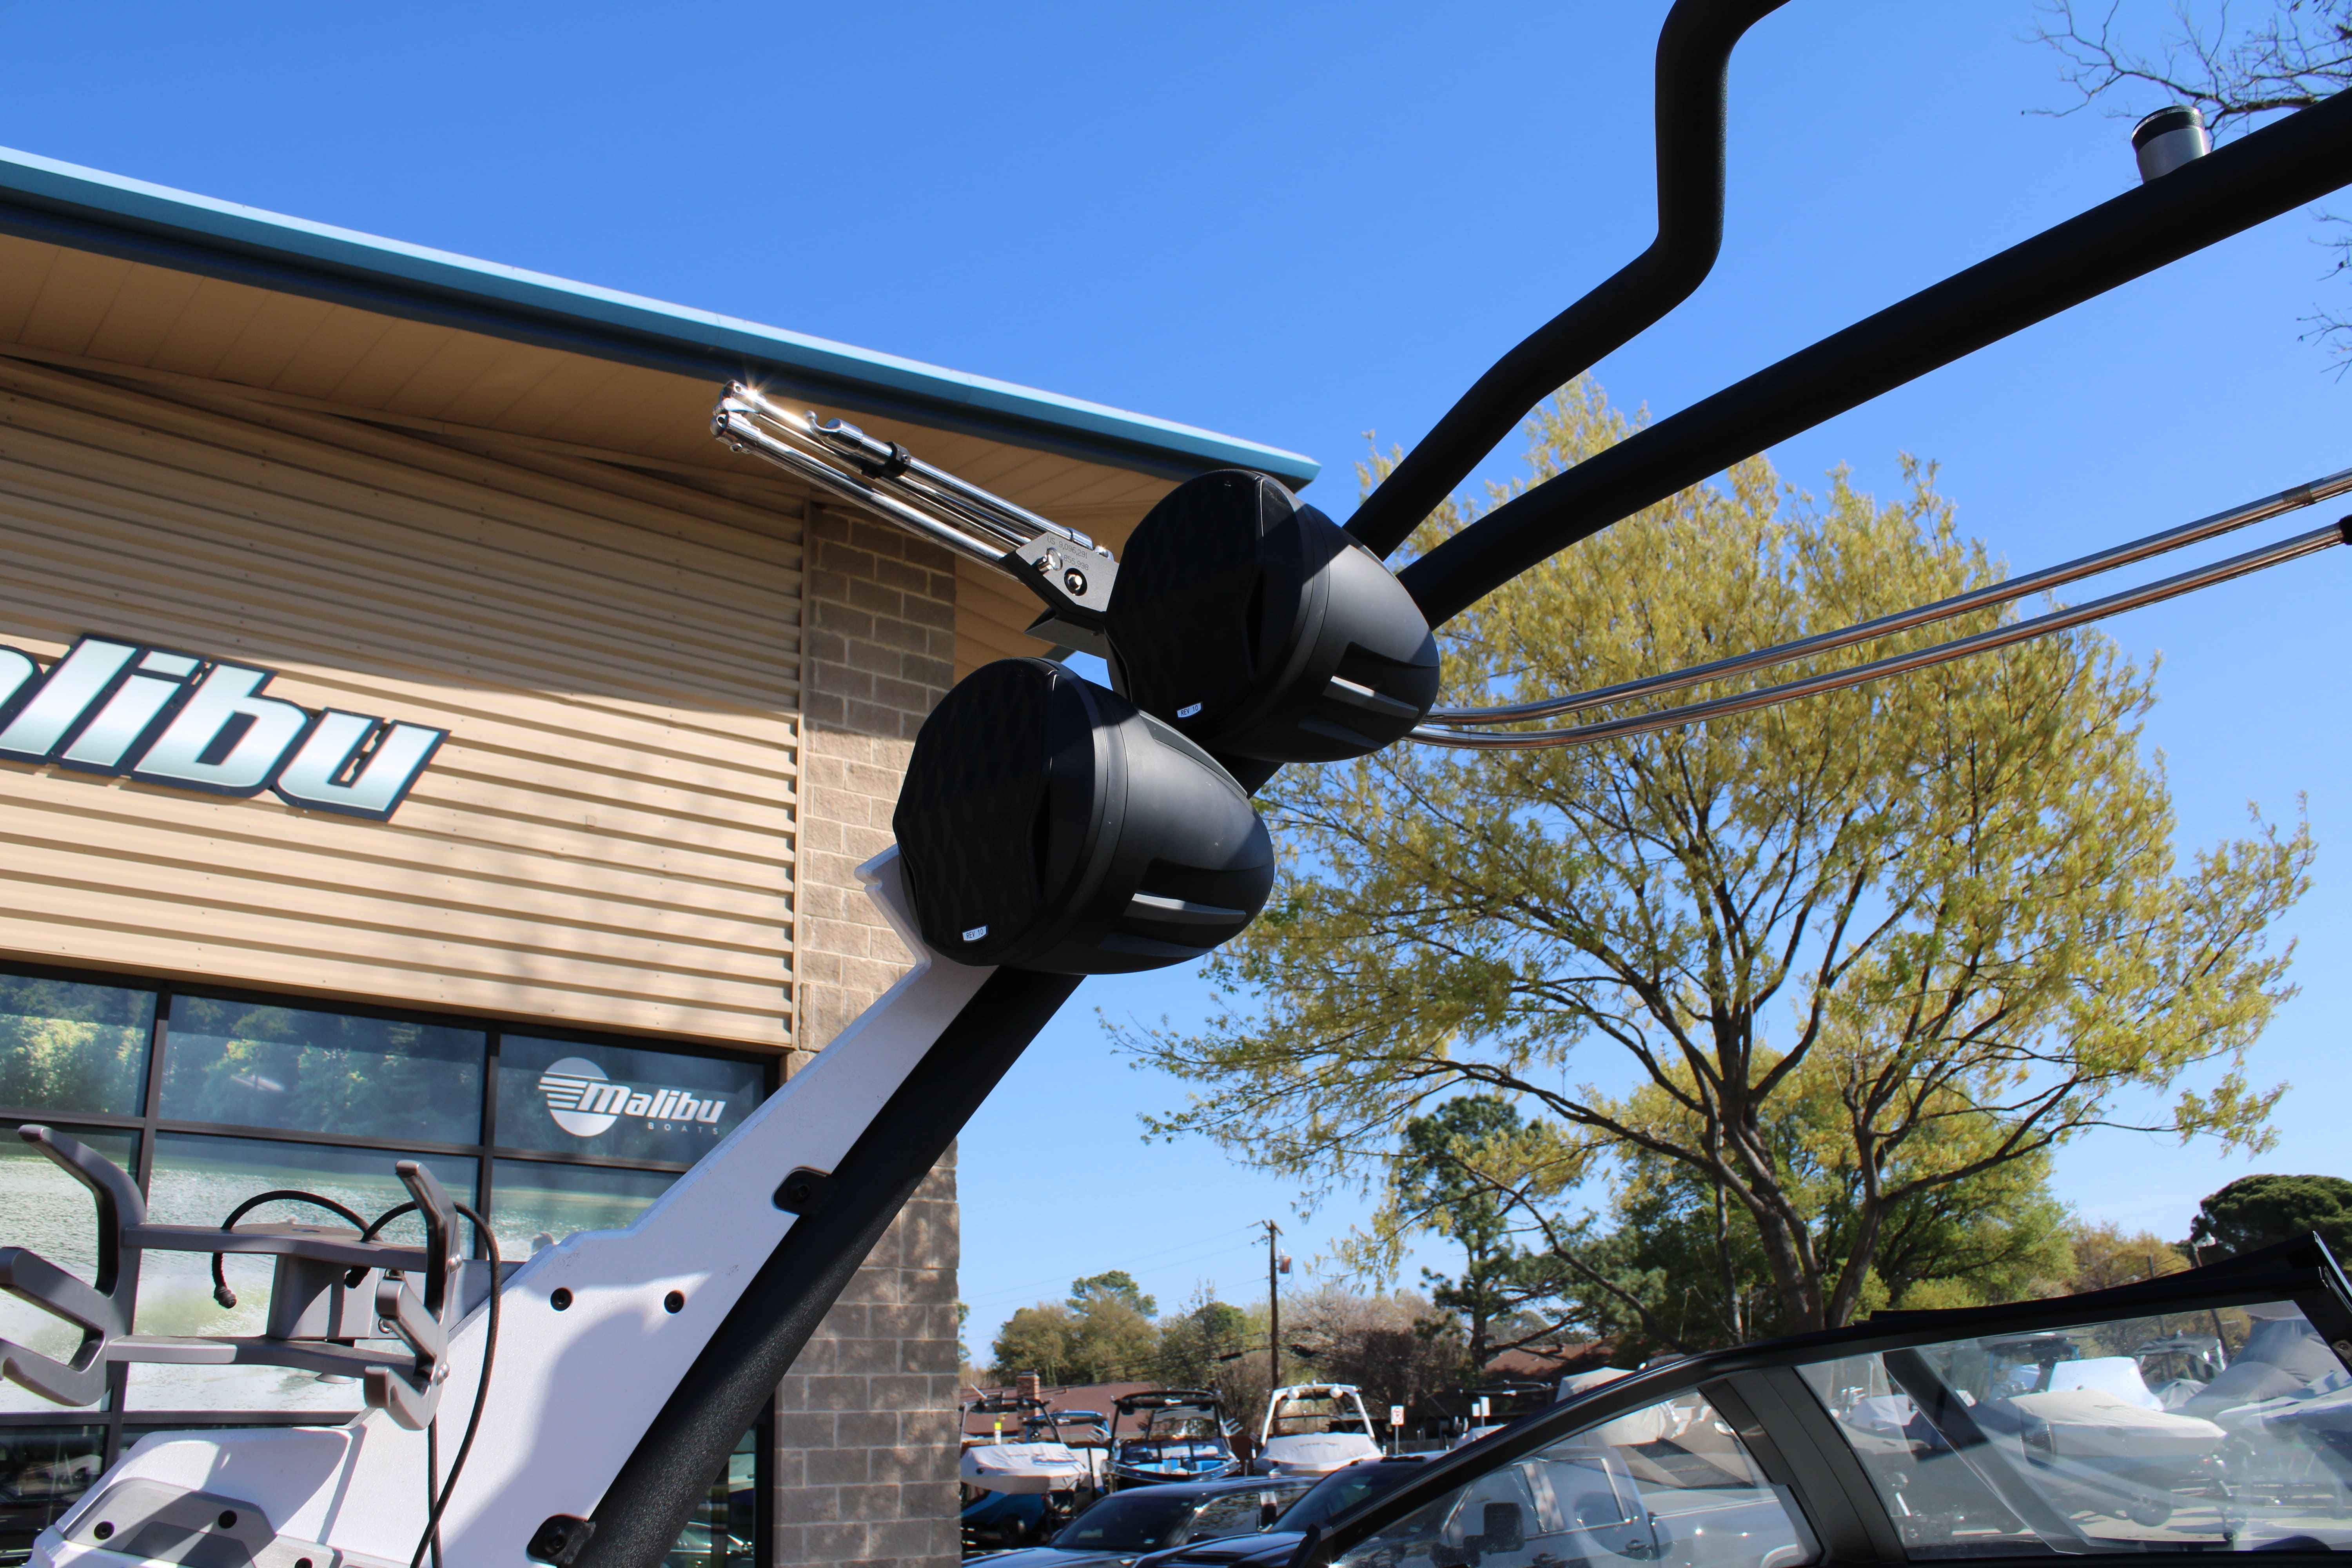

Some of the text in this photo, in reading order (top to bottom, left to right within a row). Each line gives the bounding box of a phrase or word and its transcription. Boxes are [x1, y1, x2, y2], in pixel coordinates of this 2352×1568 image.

[1047, 535, 1056, 545] US
[1058, 553, 1089, 571] ,855,998
[1181, 708, 1190, 716] REV
[0, 633, 451, 823] libu
[966, 931, 975, 939] REV
[648, 1122, 718, 1135] BOATS
